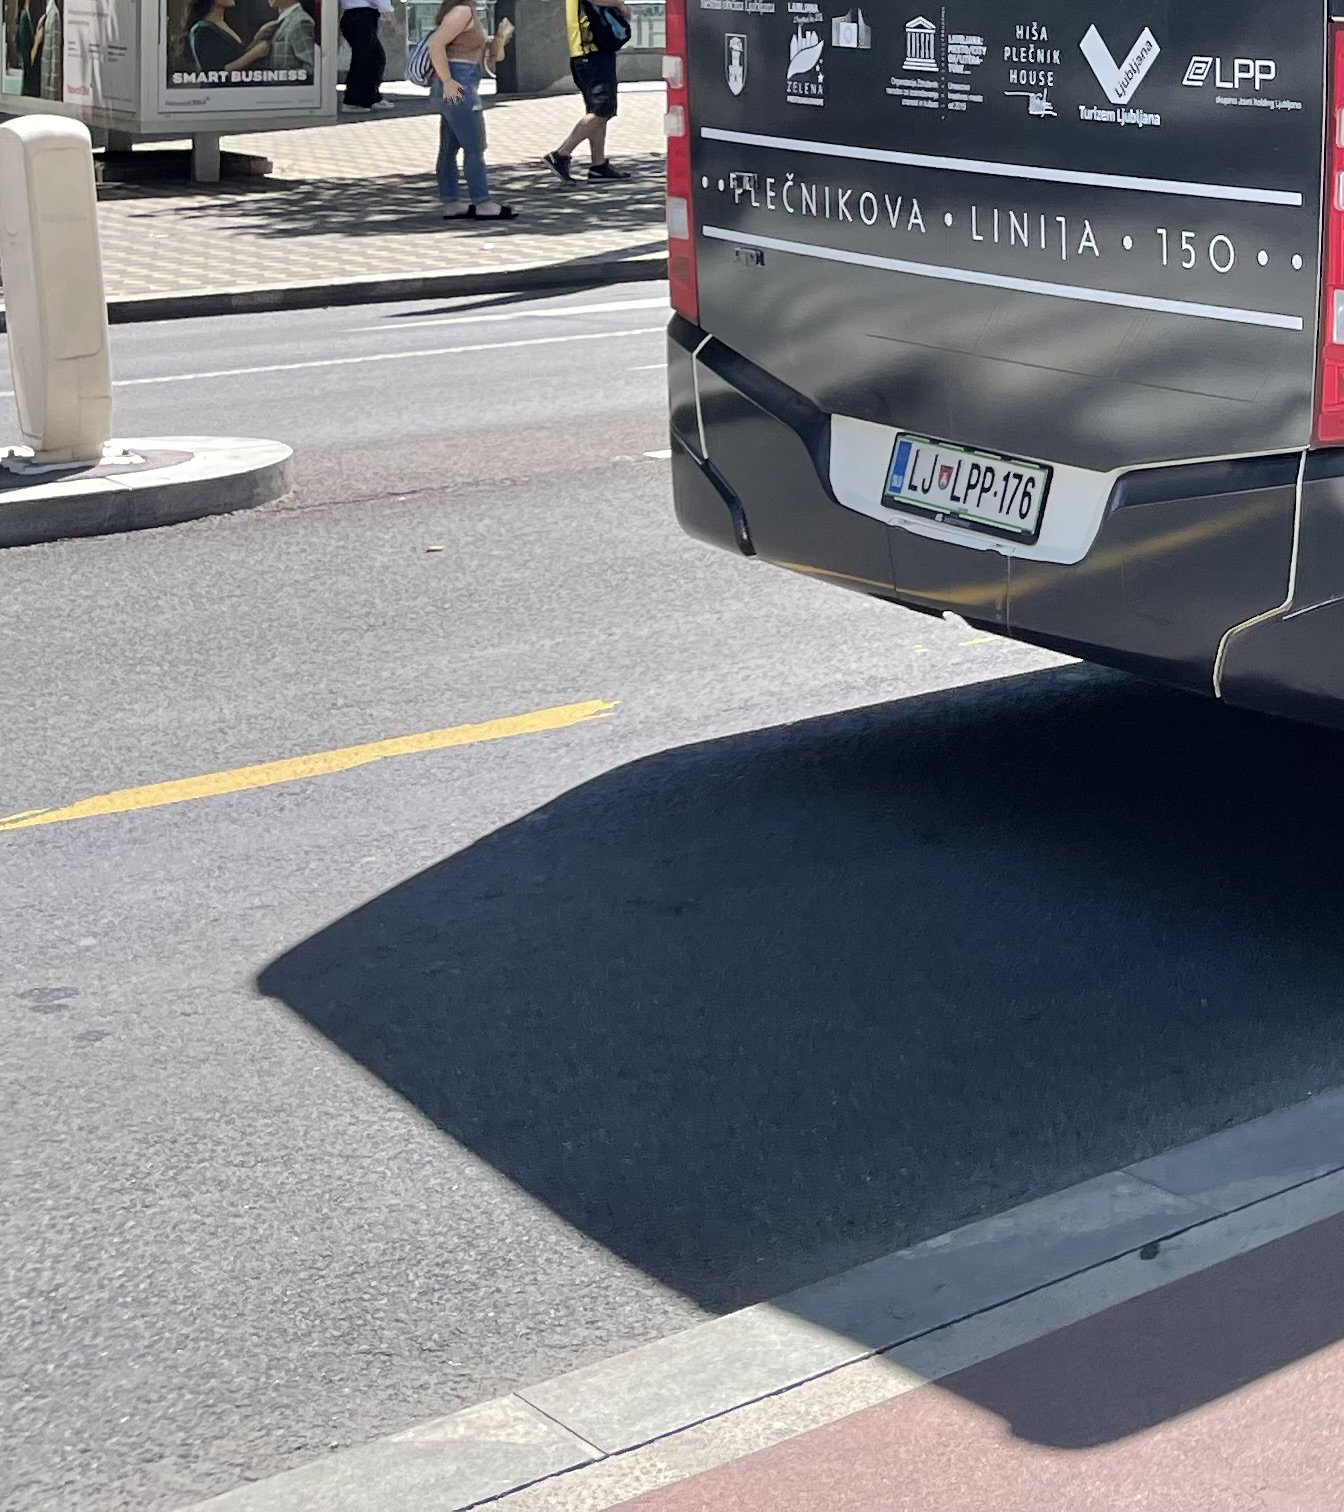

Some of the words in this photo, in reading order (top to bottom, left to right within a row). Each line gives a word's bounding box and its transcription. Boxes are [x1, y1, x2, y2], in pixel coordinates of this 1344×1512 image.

[1016, 21, 1048, 41] HIŠA
[1004, 43, 1061, 65] PLEČNIK
[173, 71, 229, 84] SMART
[231, 69, 307, 82] BUSINESS
[1009, 69, 1054, 86] HOUSE
[1115, 40, 1153, 98] Ljubljana
[1215, 57, 1276, 91] LPP
[787, 81, 823, 95] ZELENA
[1078, 105, 1116, 122] Turizem
[1117, 109, 1161, 128] Ljubljana
[729, 173, 926, 233] PLEČNIKOVA
[1156, 228, 1236, 272] 150
[908, 449, 939, 495] LJ
